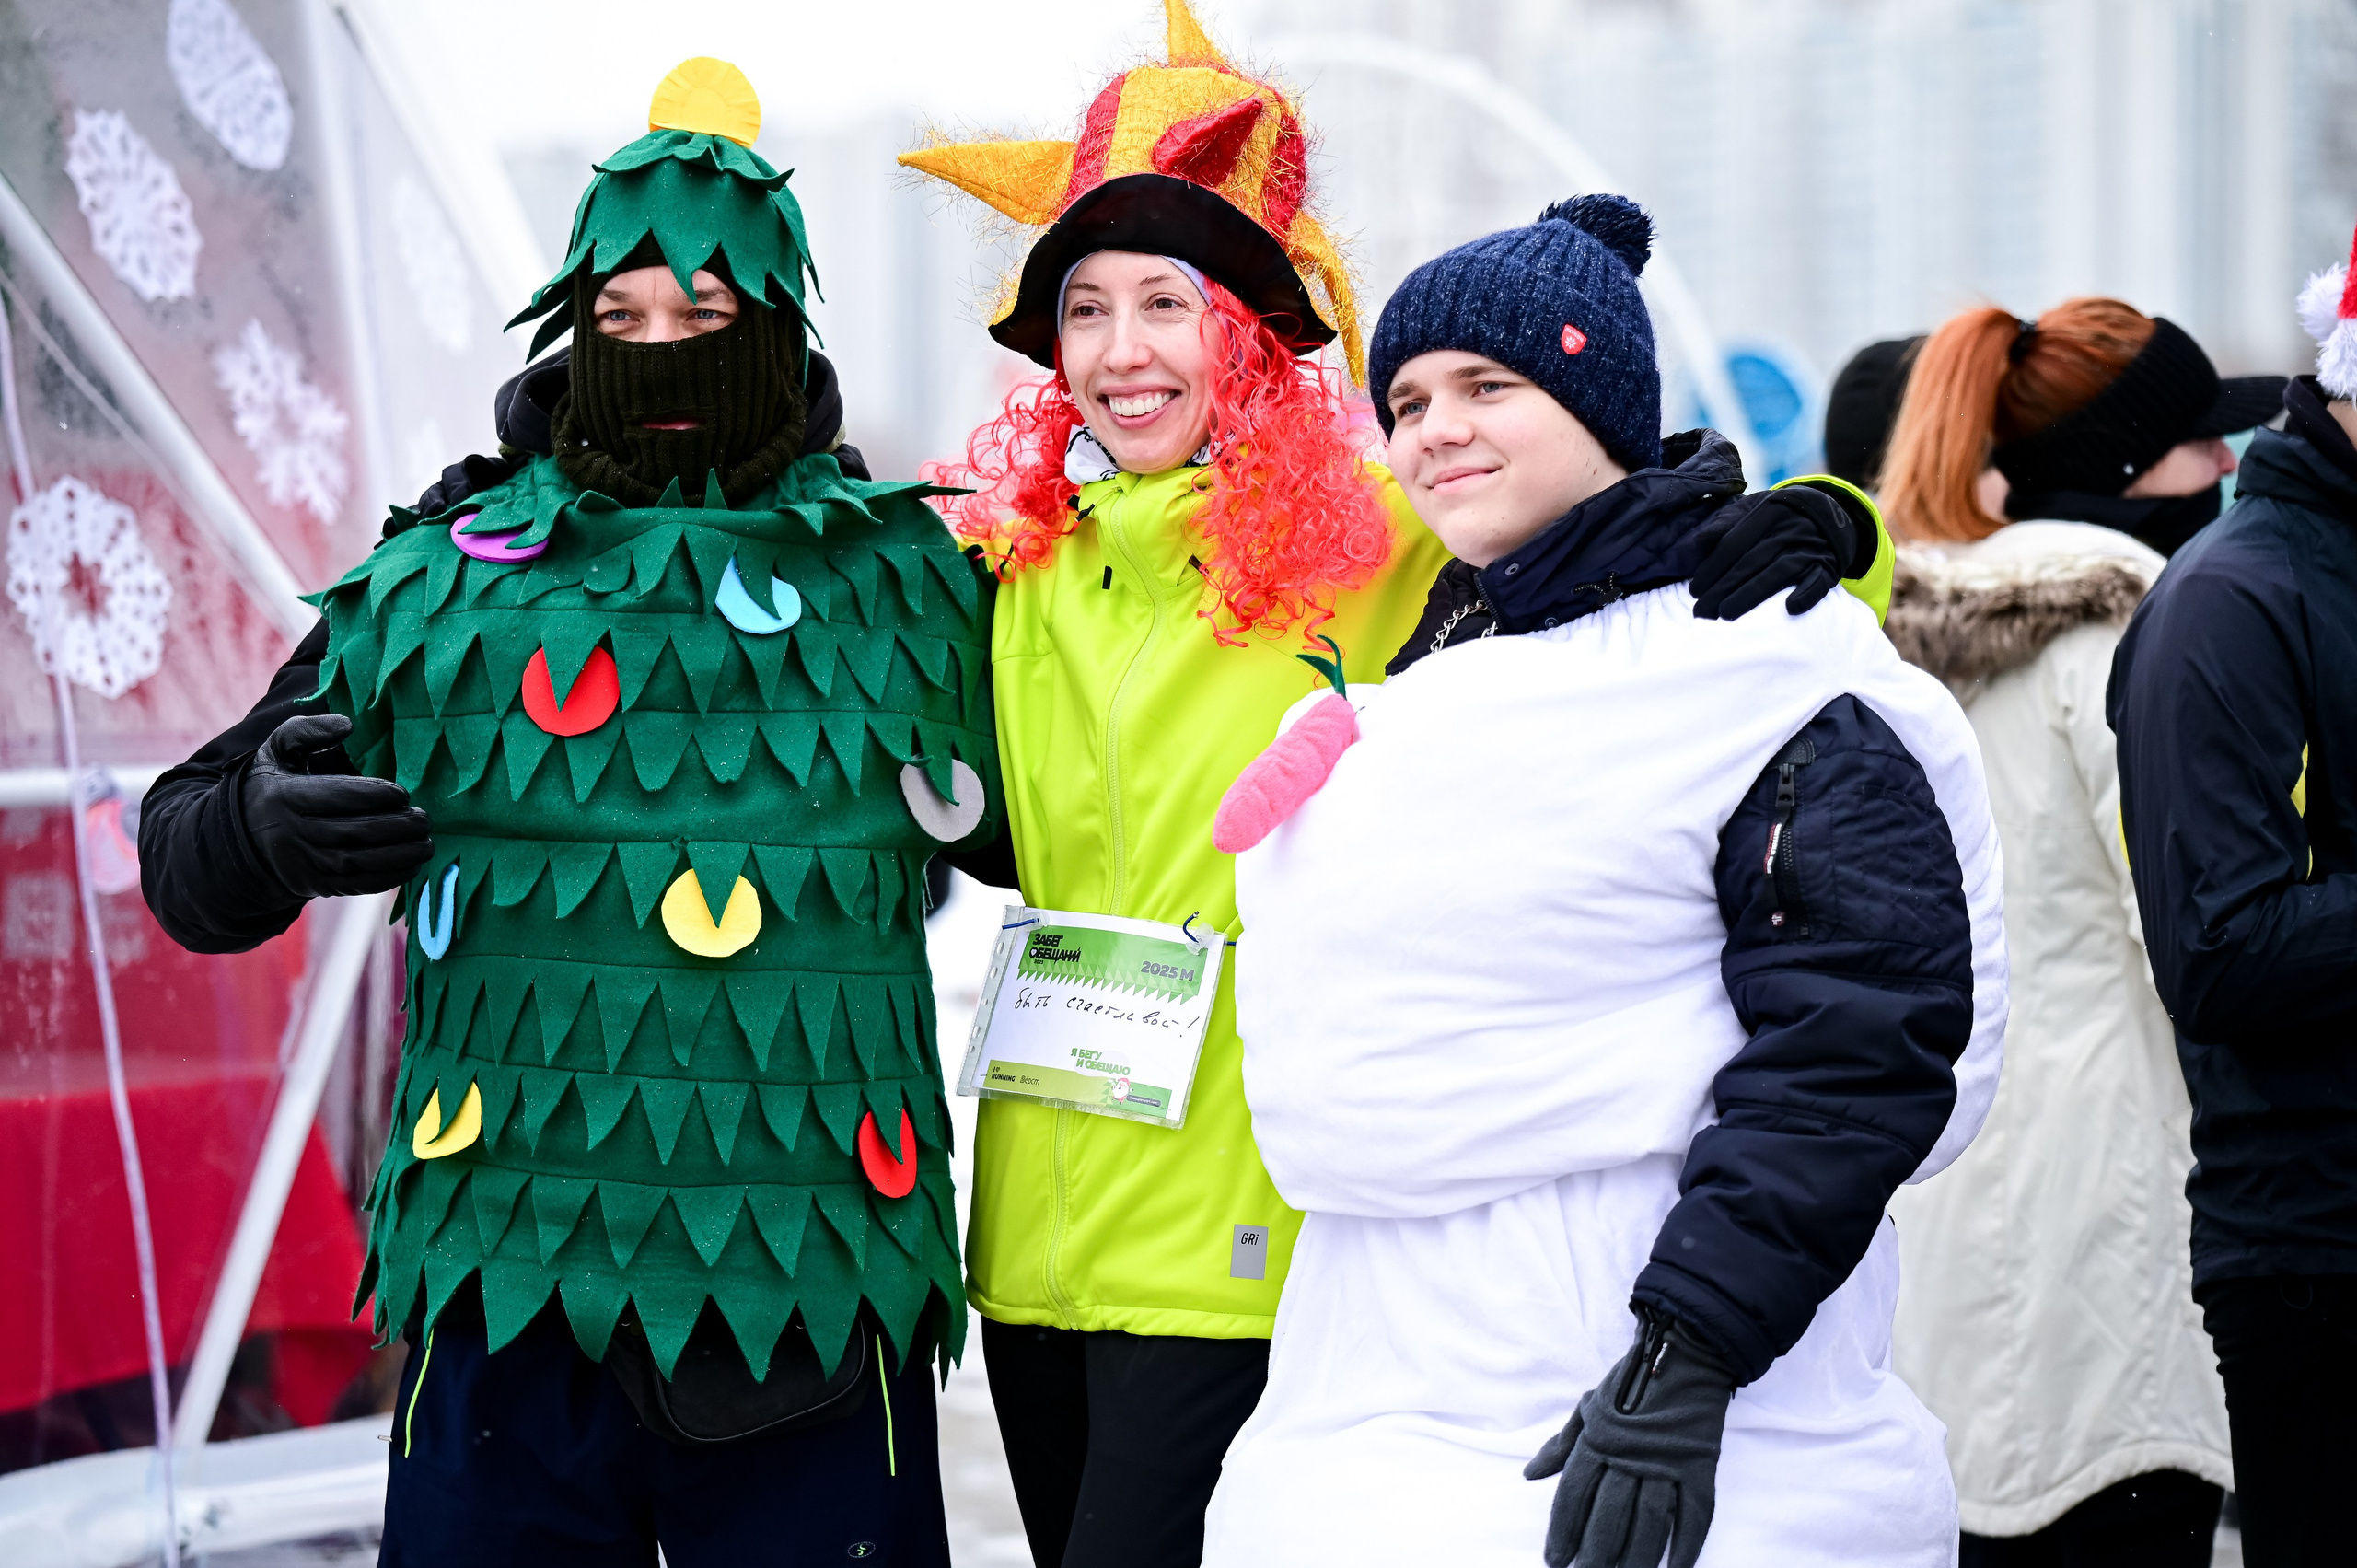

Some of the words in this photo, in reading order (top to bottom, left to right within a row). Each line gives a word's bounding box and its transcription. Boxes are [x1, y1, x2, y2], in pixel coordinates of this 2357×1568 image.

[1032, 933, 1064, 947] ЗАБЕГ
[1028, 946, 1082, 965] ОБЕЩАНИЙ
[1140, 960, 1179, 980] 2025
[1014, 986, 1051, 1010] быть
[1070, 1047, 1078, 1057] Я
[1078, 1048, 1103, 1061] БЕГУ
[1075, 1058, 1085, 1068] И
[1085, 1059, 1131, 1076] ОБЕЩАЮ
[991, 1073, 1016, 1083] RUNNING
